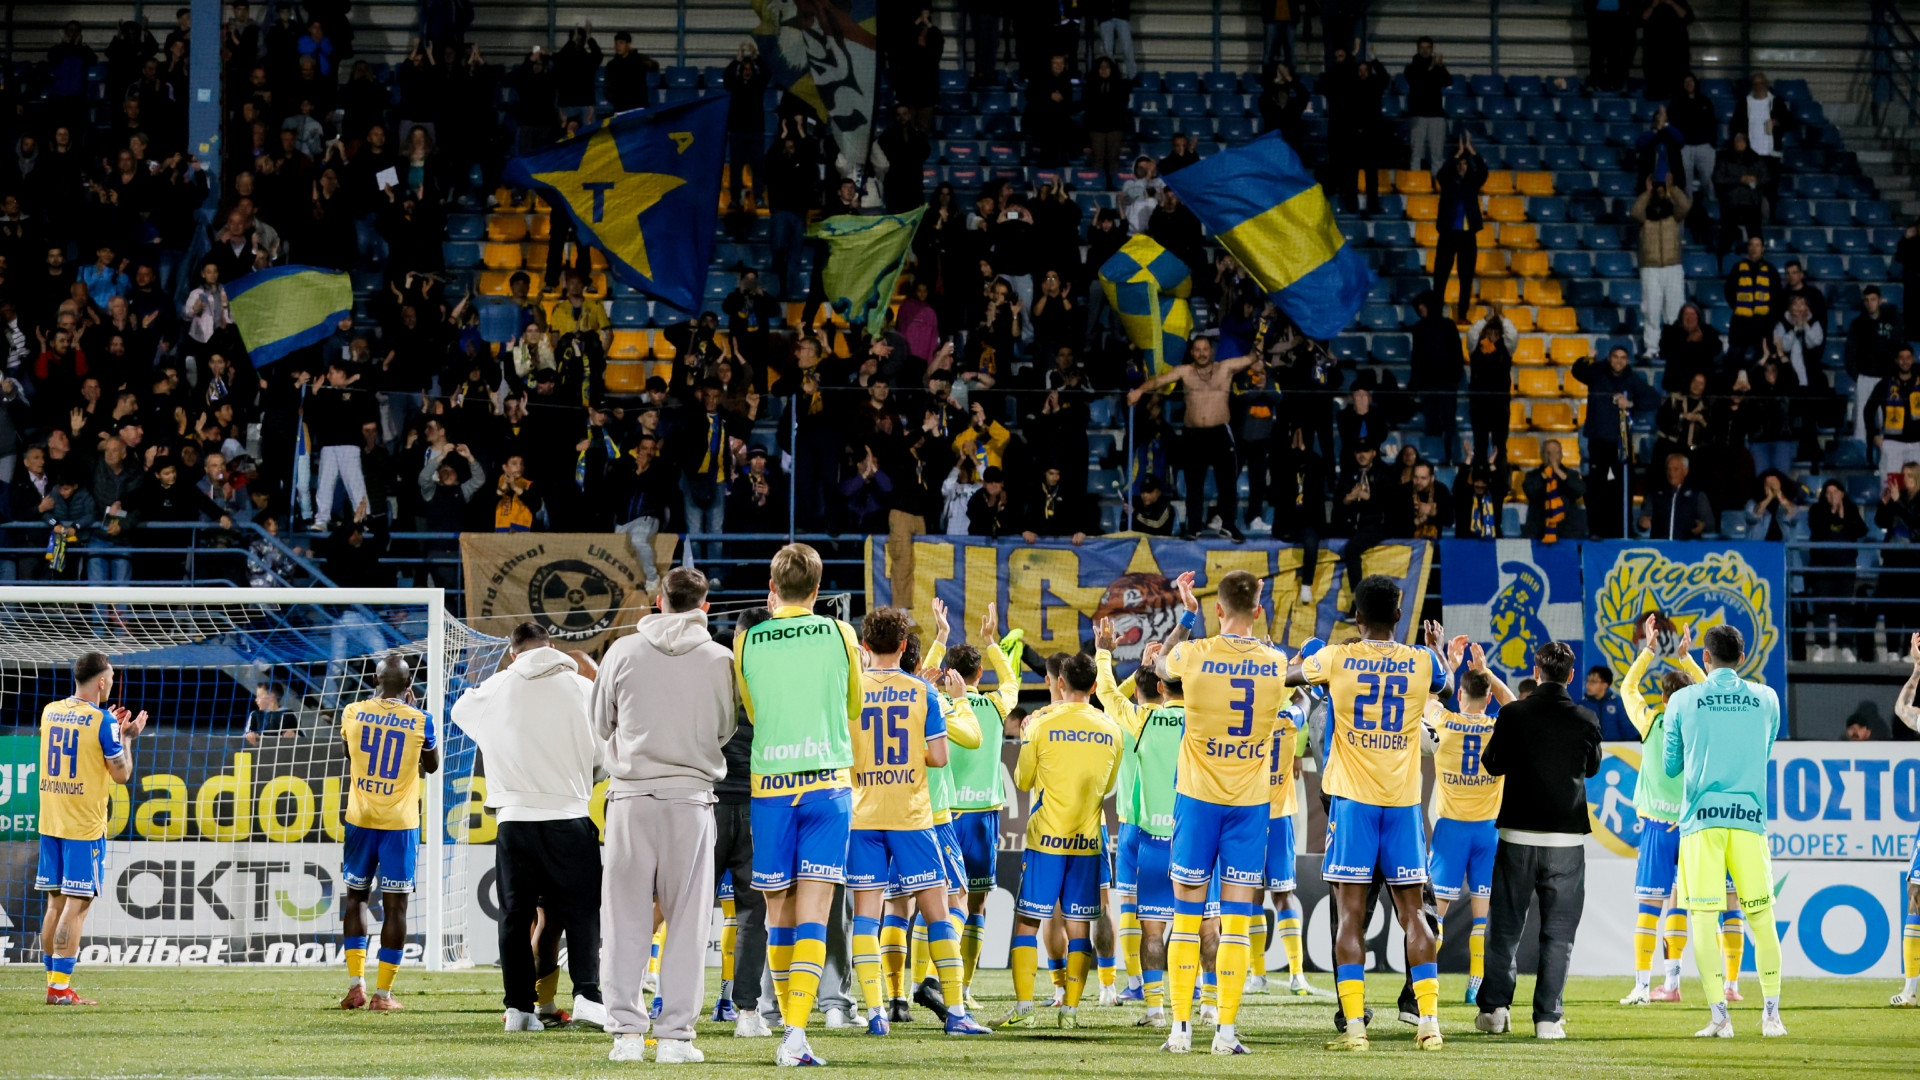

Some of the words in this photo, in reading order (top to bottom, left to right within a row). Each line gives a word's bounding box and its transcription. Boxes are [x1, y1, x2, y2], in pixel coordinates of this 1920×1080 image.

[588, 543, 635, 582] Ultras
[1624, 552, 1745, 597] Tigers
[752, 624, 831, 645] macron
[1201, 659, 1279, 677] novibet
[1343, 656, 1416, 674] novibet
[1227, 678, 1255, 736] 3
[1353, 673, 1408, 732] 26
[1697, 694, 1761, 709] ASTERAS
[47, 711, 93, 727] novibet
[355, 712, 417, 731] novibet
[861, 706, 909, 766] 75
[1049, 729, 1113, 746] macron
[1361, 733, 1408, 750] CHIDERA
[47, 726, 79, 779] 64
[360, 725, 405, 780] 40
[1206, 737, 1265, 760] ŠIPČIĆ
[1461, 734, 1482, 776] 8
[357, 777, 394, 796] KETU
[761, 768, 837, 790] novibet
[1697, 803, 1763, 823] novibet
[1040, 833, 1099, 850] novibet
[801, 860, 843, 876] Promist
[76, 937, 229, 966] ovibet
